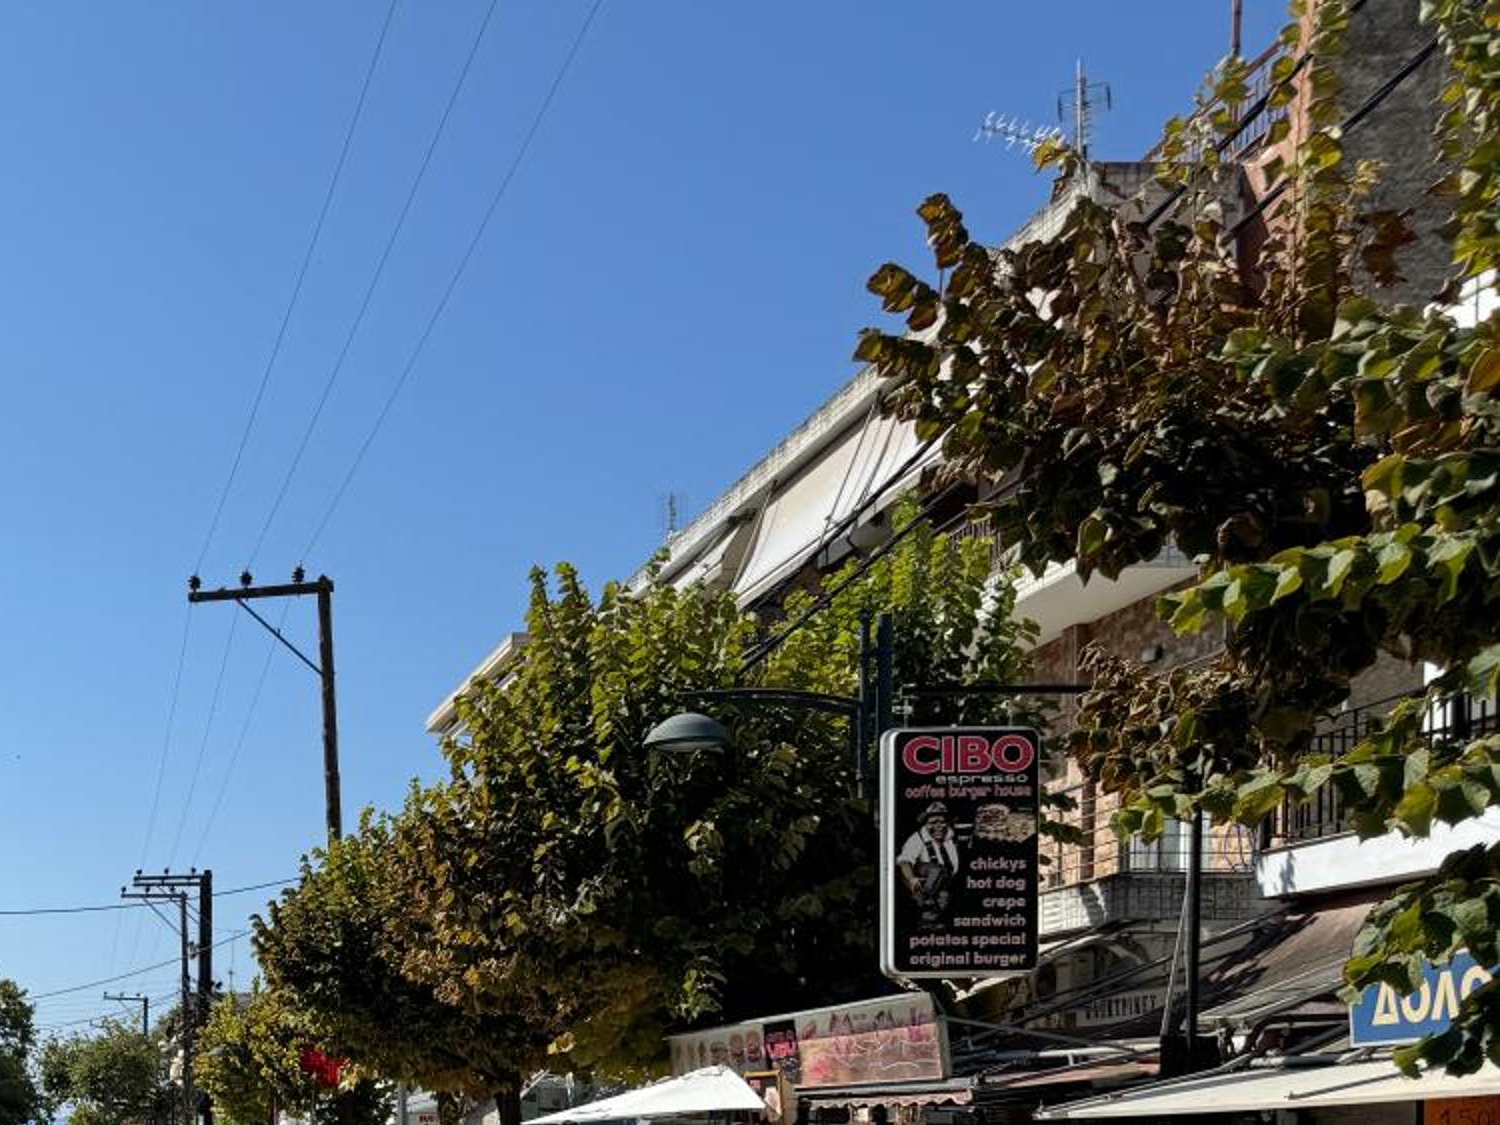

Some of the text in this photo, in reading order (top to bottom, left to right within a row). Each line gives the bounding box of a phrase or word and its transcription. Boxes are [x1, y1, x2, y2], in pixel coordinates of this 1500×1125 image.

[902, 734, 1035, 774] CIBO
[935, 774, 1029, 785] espresso
[904, 783, 1032, 800] coffee burger house
[969, 857, 1027, 872] chickys
[966, 876, 1027, 891] hot dog
[982, 896, 1027, 909] crepe
[953, 914, 1027, 927] sandwich
[971, 932, 1027, 948] special
[909, 952, 1027, 968] original burger
